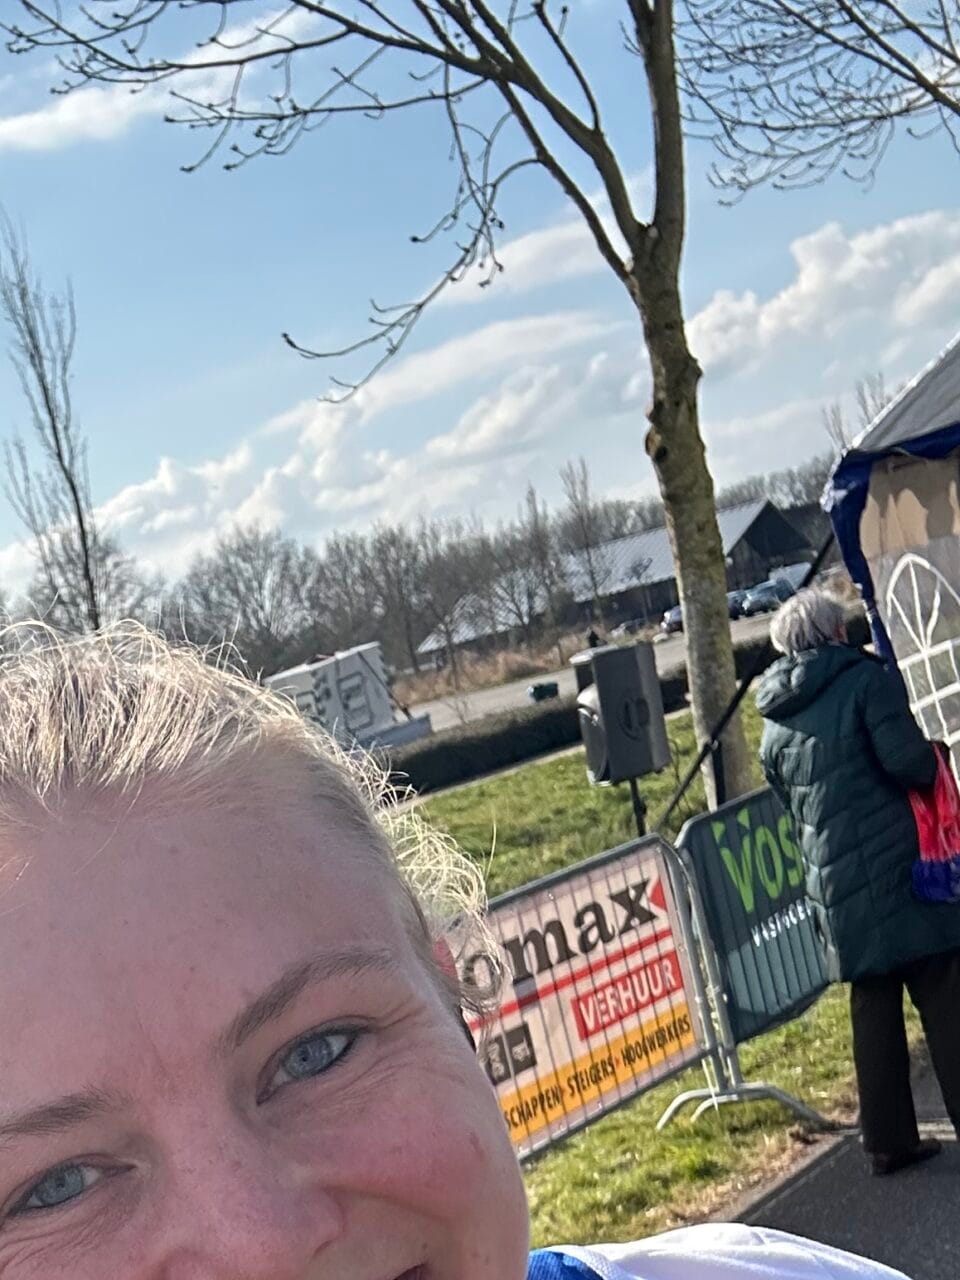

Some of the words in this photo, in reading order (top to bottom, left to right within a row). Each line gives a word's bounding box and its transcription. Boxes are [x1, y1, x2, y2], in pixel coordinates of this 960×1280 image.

[580, 958, 677, 1031] VERHUUR
[567, 1056, 616, 1097] STEIGERS
[620, 1014, 690, 1067] HOOGWERKERS
